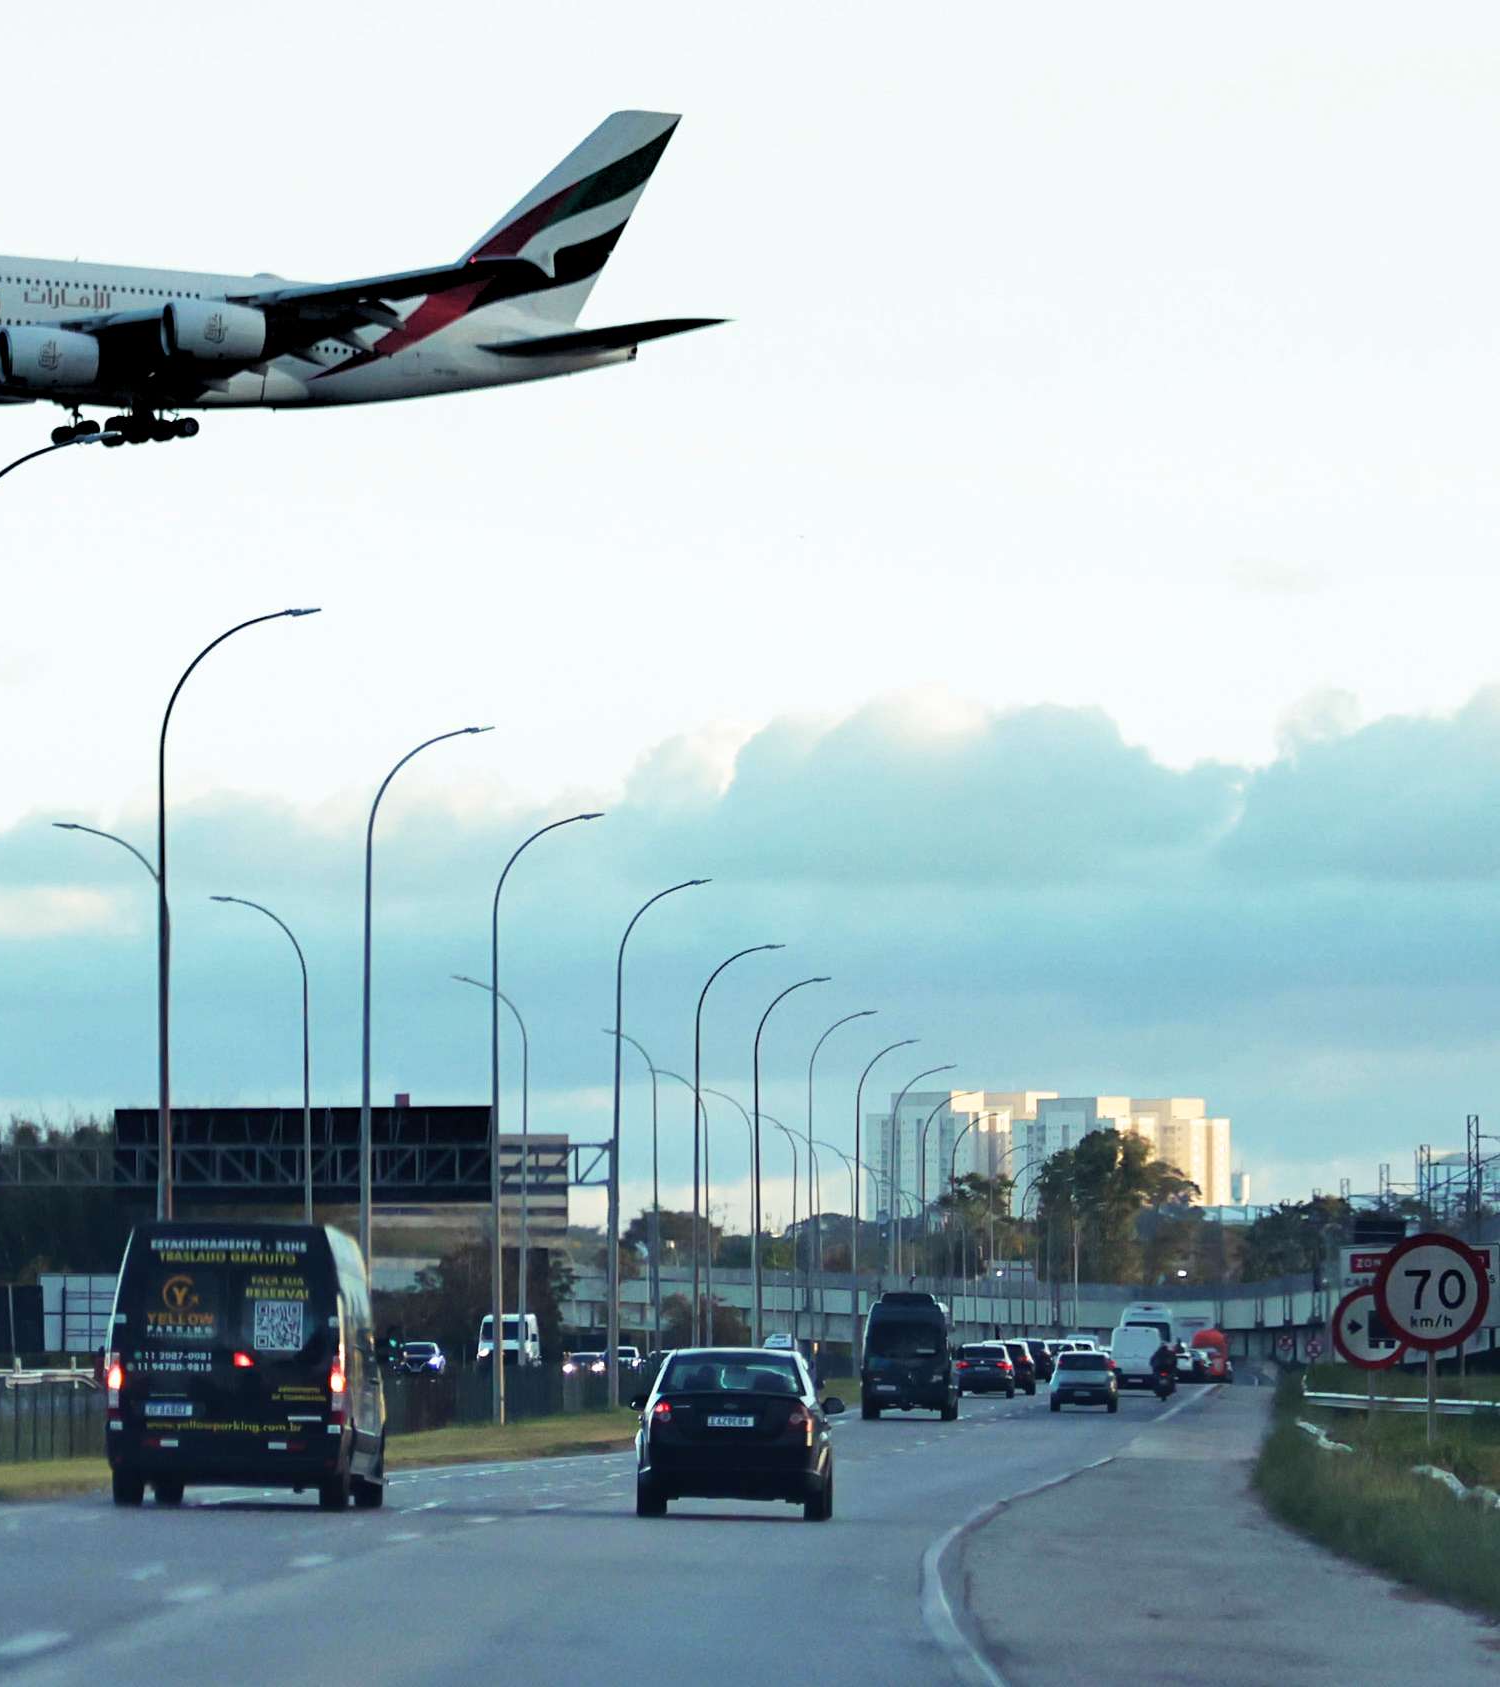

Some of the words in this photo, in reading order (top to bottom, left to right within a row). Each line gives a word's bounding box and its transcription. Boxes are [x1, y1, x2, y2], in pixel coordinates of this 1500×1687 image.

[150, 1239, 262, 1251] ESTACIONAMENTO
[159, 1251, 227, 1263] TRASLADO
[230, 1252, 296, 1265] GRATUITO
[1404, 1269, 1467, 1310] 70
[147, 1312, 213, 1325] YELLOW
[1409, 1313, 1453, 1329] km/h
[146, 1325, 213, 1334] PARKING
